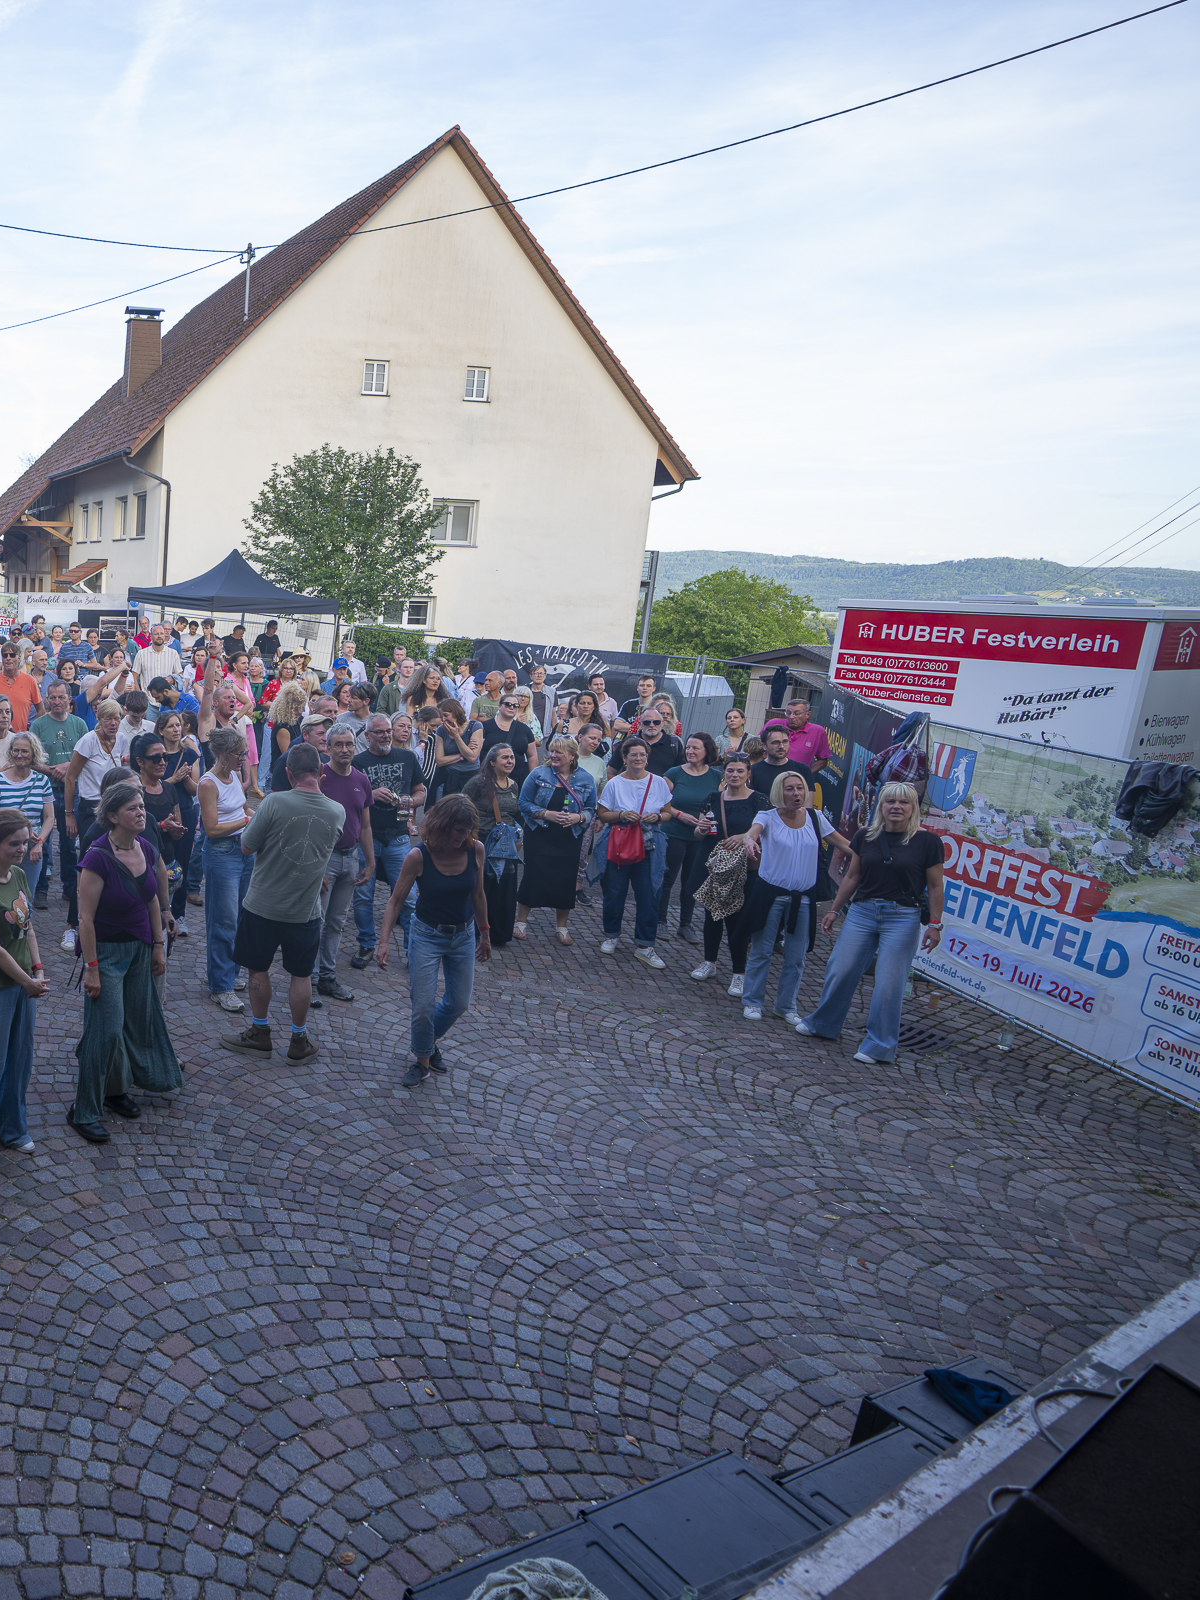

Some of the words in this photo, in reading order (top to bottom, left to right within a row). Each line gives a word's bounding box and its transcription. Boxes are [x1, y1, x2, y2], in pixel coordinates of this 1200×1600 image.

[26, 595, 61, 605] Breitenfeld
[881, 623, 965, 644] HUBER
[972, 628, 1120, 653] Festverleih
[512, 646, 533, 670] LES
[843, 655, 858, 664] Tel.
[860, 656, 883, 666] 0049
[885, 659, 949, 671] (0)7761/3600
[840, 669, 857, 679] Fax
[859, 671, 882, 681] 0049
[883, 673, 946, 687] (0)7761/3444
[1037, 687, 1082, 704] tanzt
[1083, 685, 1115, 699] der
[1151, 714, 1190, 729] Bierwagen
[1145, 733, 1187, 748] Kühlwagen
[942, 835, 1091, 914] ORFFEST
[942, 880, 1130, 979] EITENFELD
[1156, 945, 1191, 964] 19:00
[1007, 965, 1043, 992] Juli
[1047, 981, 1096, 1014] 2026
[1153, 999, 1169, 1011] ab
[1172, 1004, 1185, 1017] 16
[1148, 1051, 1166, 1062] ab
[1169, 1056, 1182, 1070] 12
